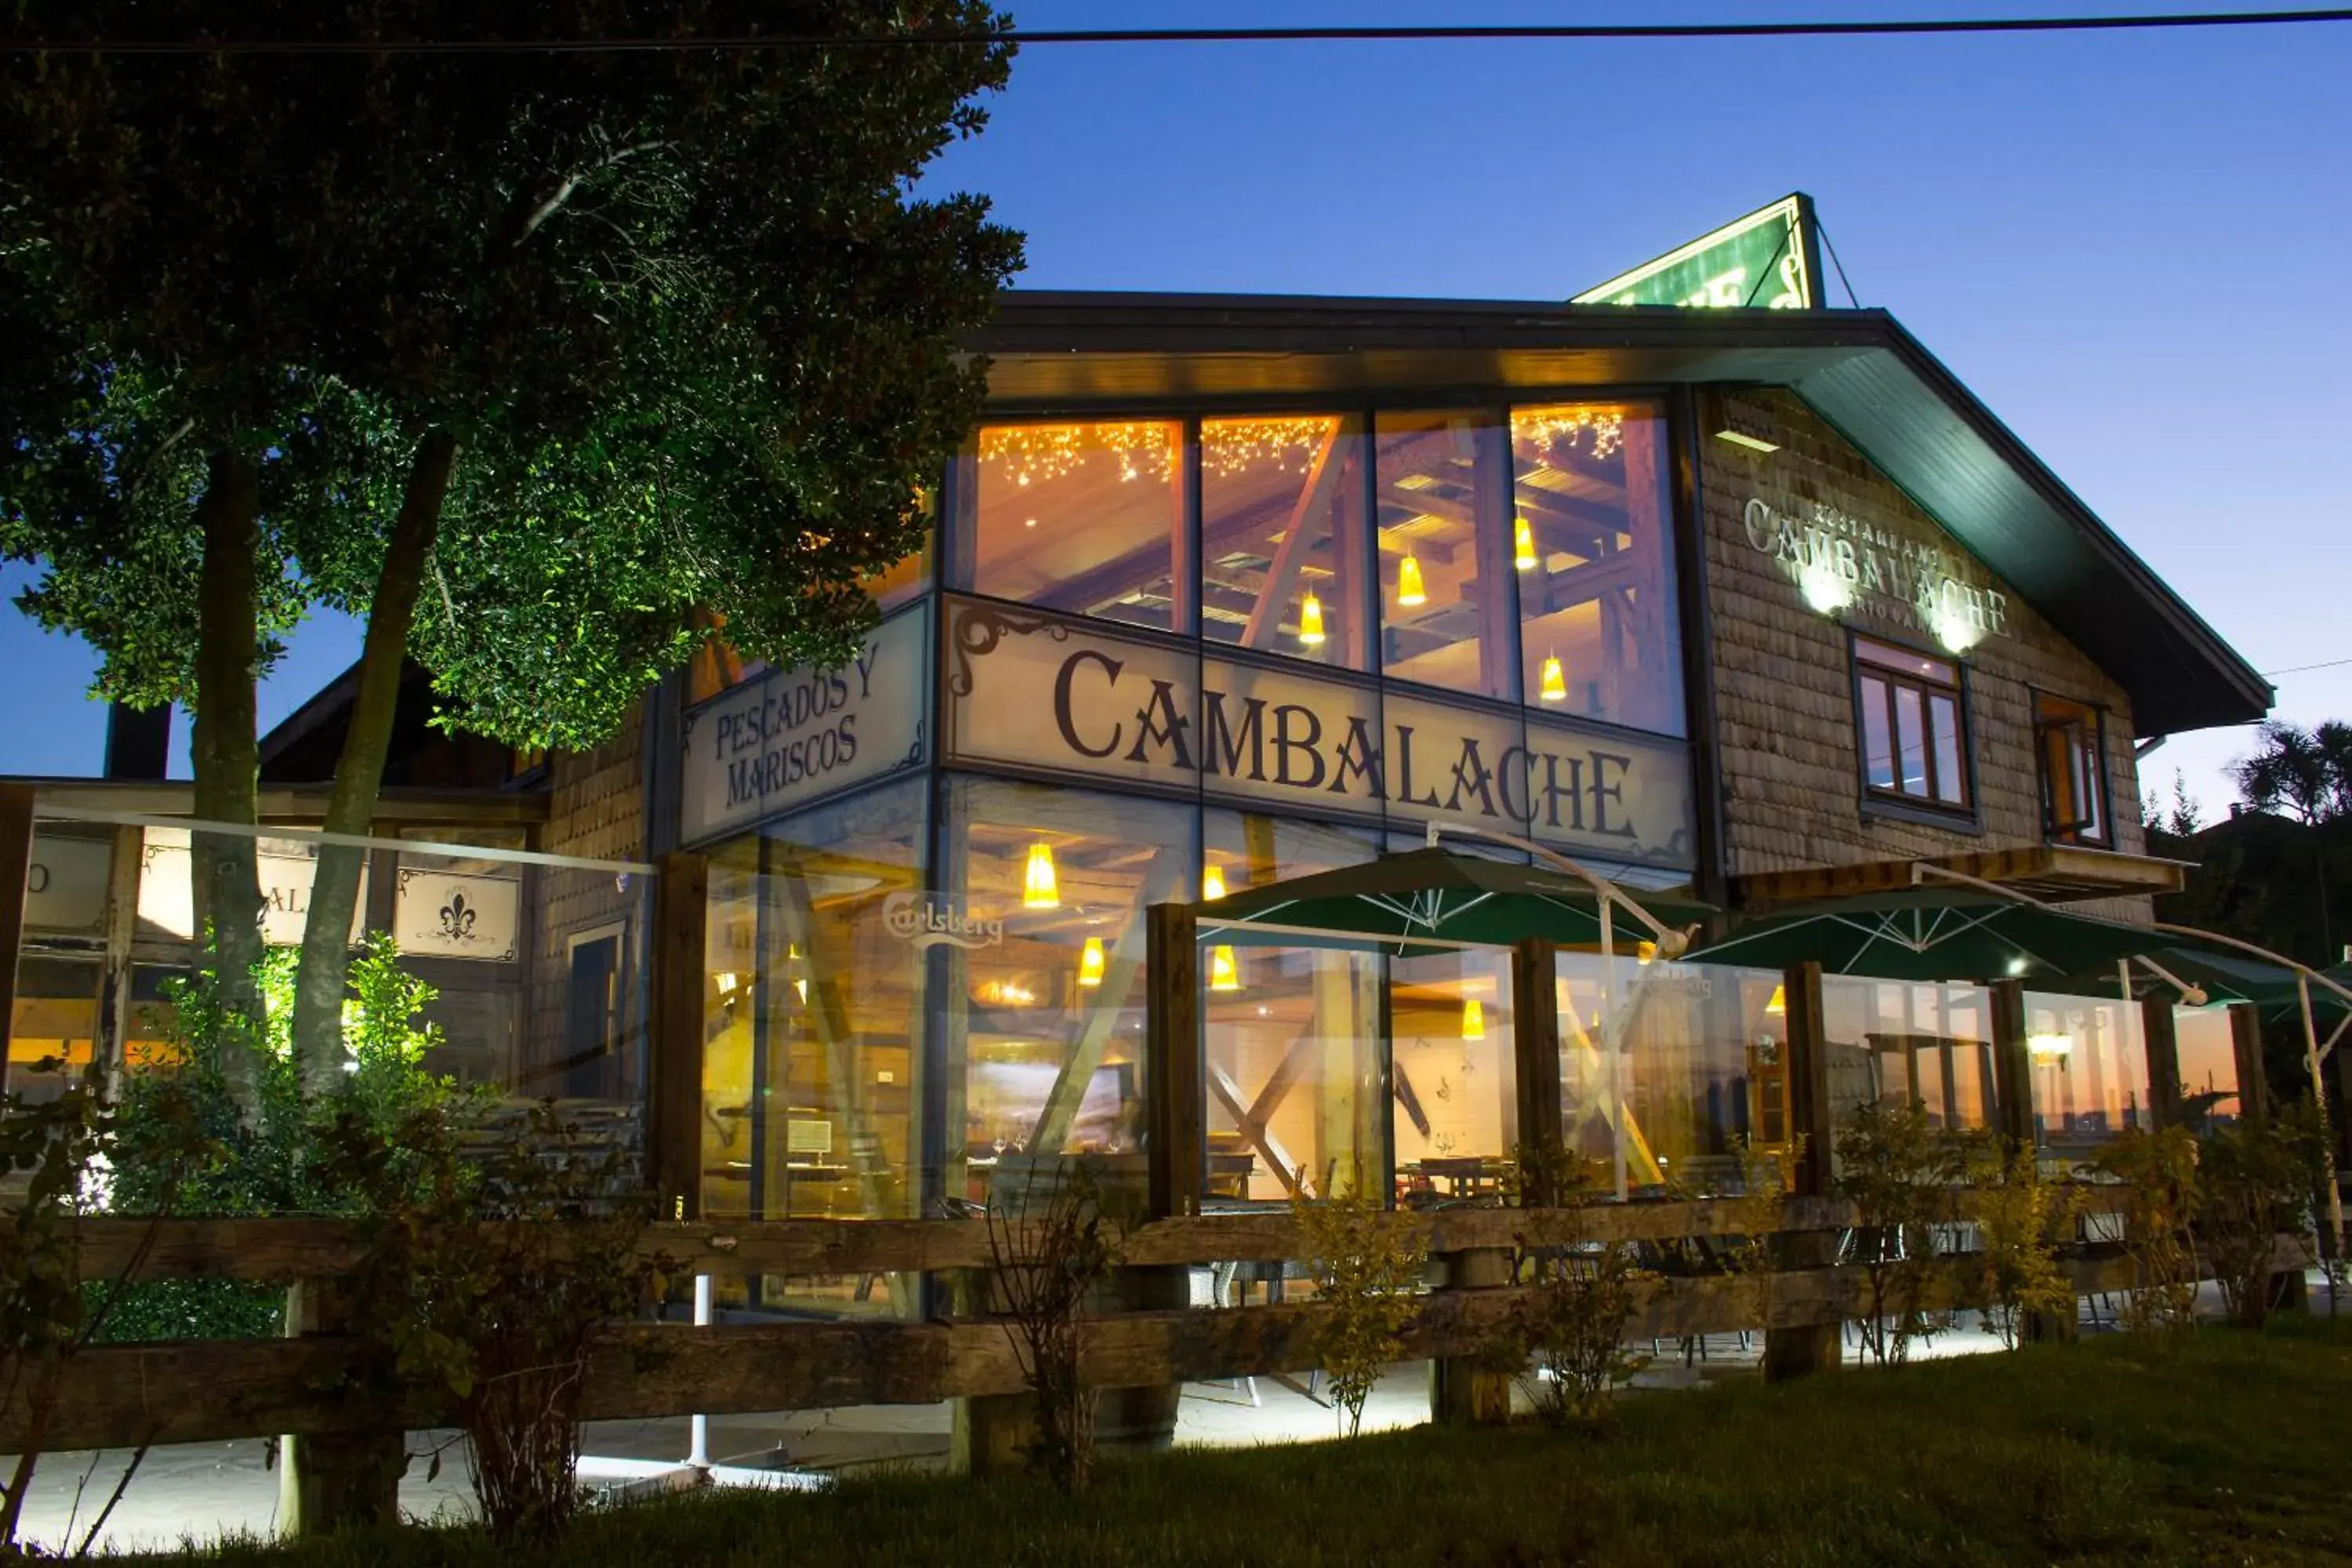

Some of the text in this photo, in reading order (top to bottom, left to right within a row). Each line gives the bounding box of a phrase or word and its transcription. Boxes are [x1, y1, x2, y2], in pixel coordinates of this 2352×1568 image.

[1744, 498, 2012, 637] CAMBALACHE
[716, 640, 880, 760] PESCADOS Y
[1054, 649, 1639, 839] CAMBALACHE
[726, 714, 857, 809] MARISCOS
[882, 891, 1004, 947] Carlsberg
